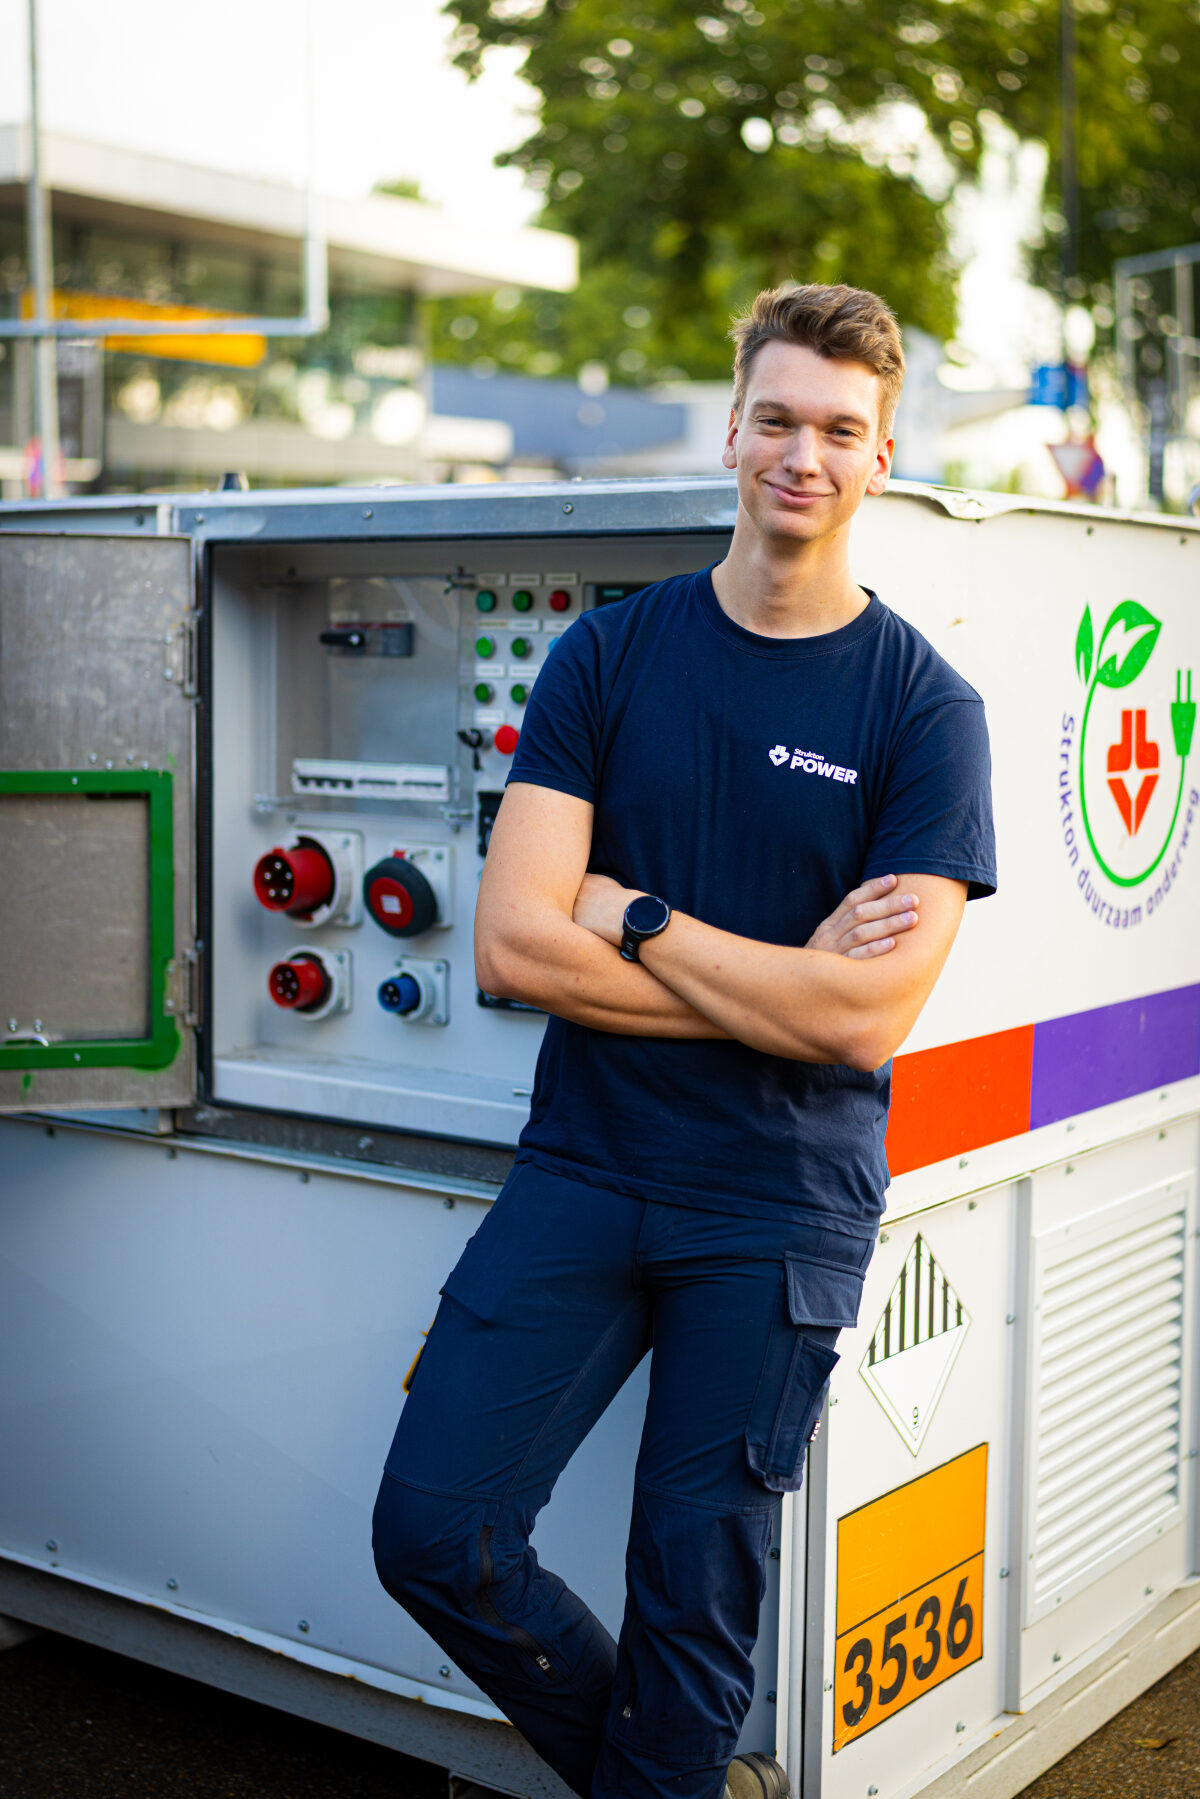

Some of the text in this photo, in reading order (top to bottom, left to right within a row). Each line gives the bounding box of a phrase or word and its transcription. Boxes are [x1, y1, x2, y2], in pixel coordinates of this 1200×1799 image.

[793, 748, 825, 761] Strukton
[789, 755, 858, 785] POWER
[1059, 712, 1199, 928] Strukton duurzaam onderweg
[912, 1406, 919, 1425] 9
[842, 1575, 974, 1728] 3536
